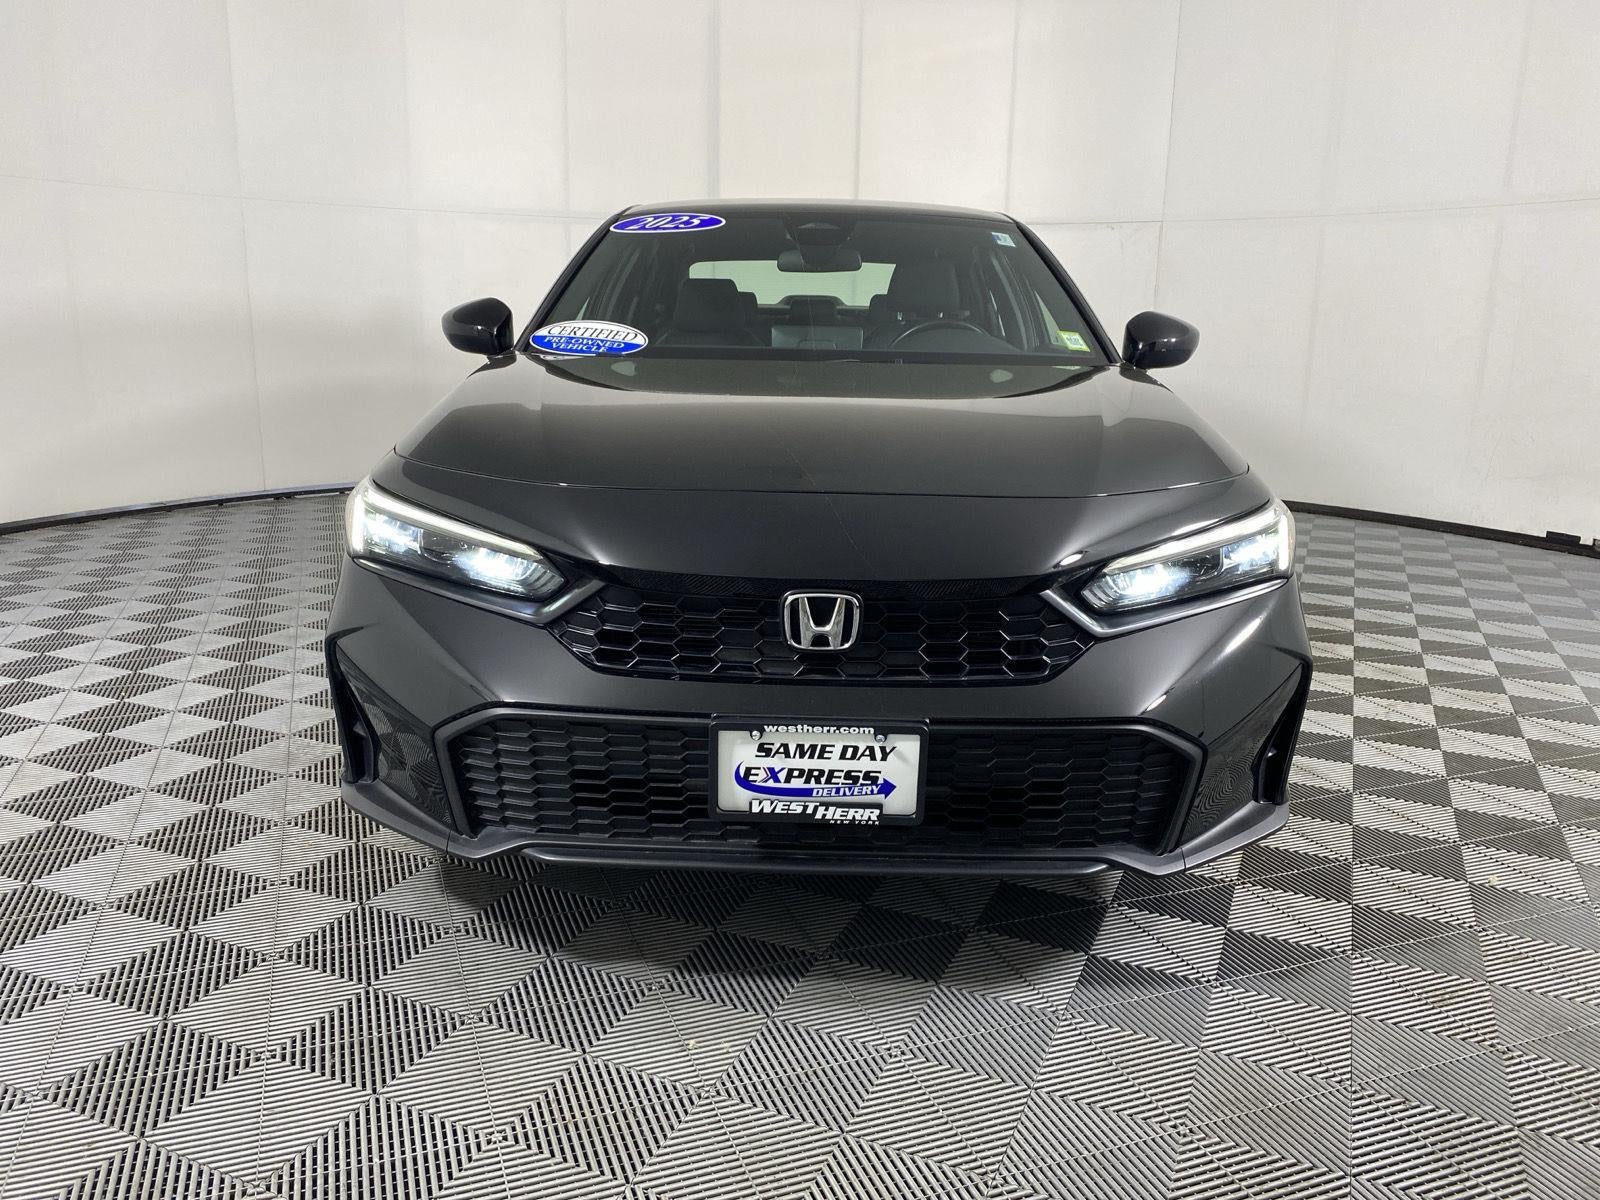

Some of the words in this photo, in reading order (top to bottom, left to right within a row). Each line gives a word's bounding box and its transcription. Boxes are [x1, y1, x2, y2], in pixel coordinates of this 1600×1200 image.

[624, 216, 711, 230] 2025
[548, 325, 638, 342] CERTIFIED
[544, 336, 625, 349] PRE-OWNED
[552, 342, 609, 353] VEHICLE
[763, 724, 875, 735] westherr.com
[755, 742, 835, 760] SAME
[839, 745, 897, 762] DAY
[742, 766, 882, 786] EXPRESS
[812, 785, 881, 797] DELIVERY
